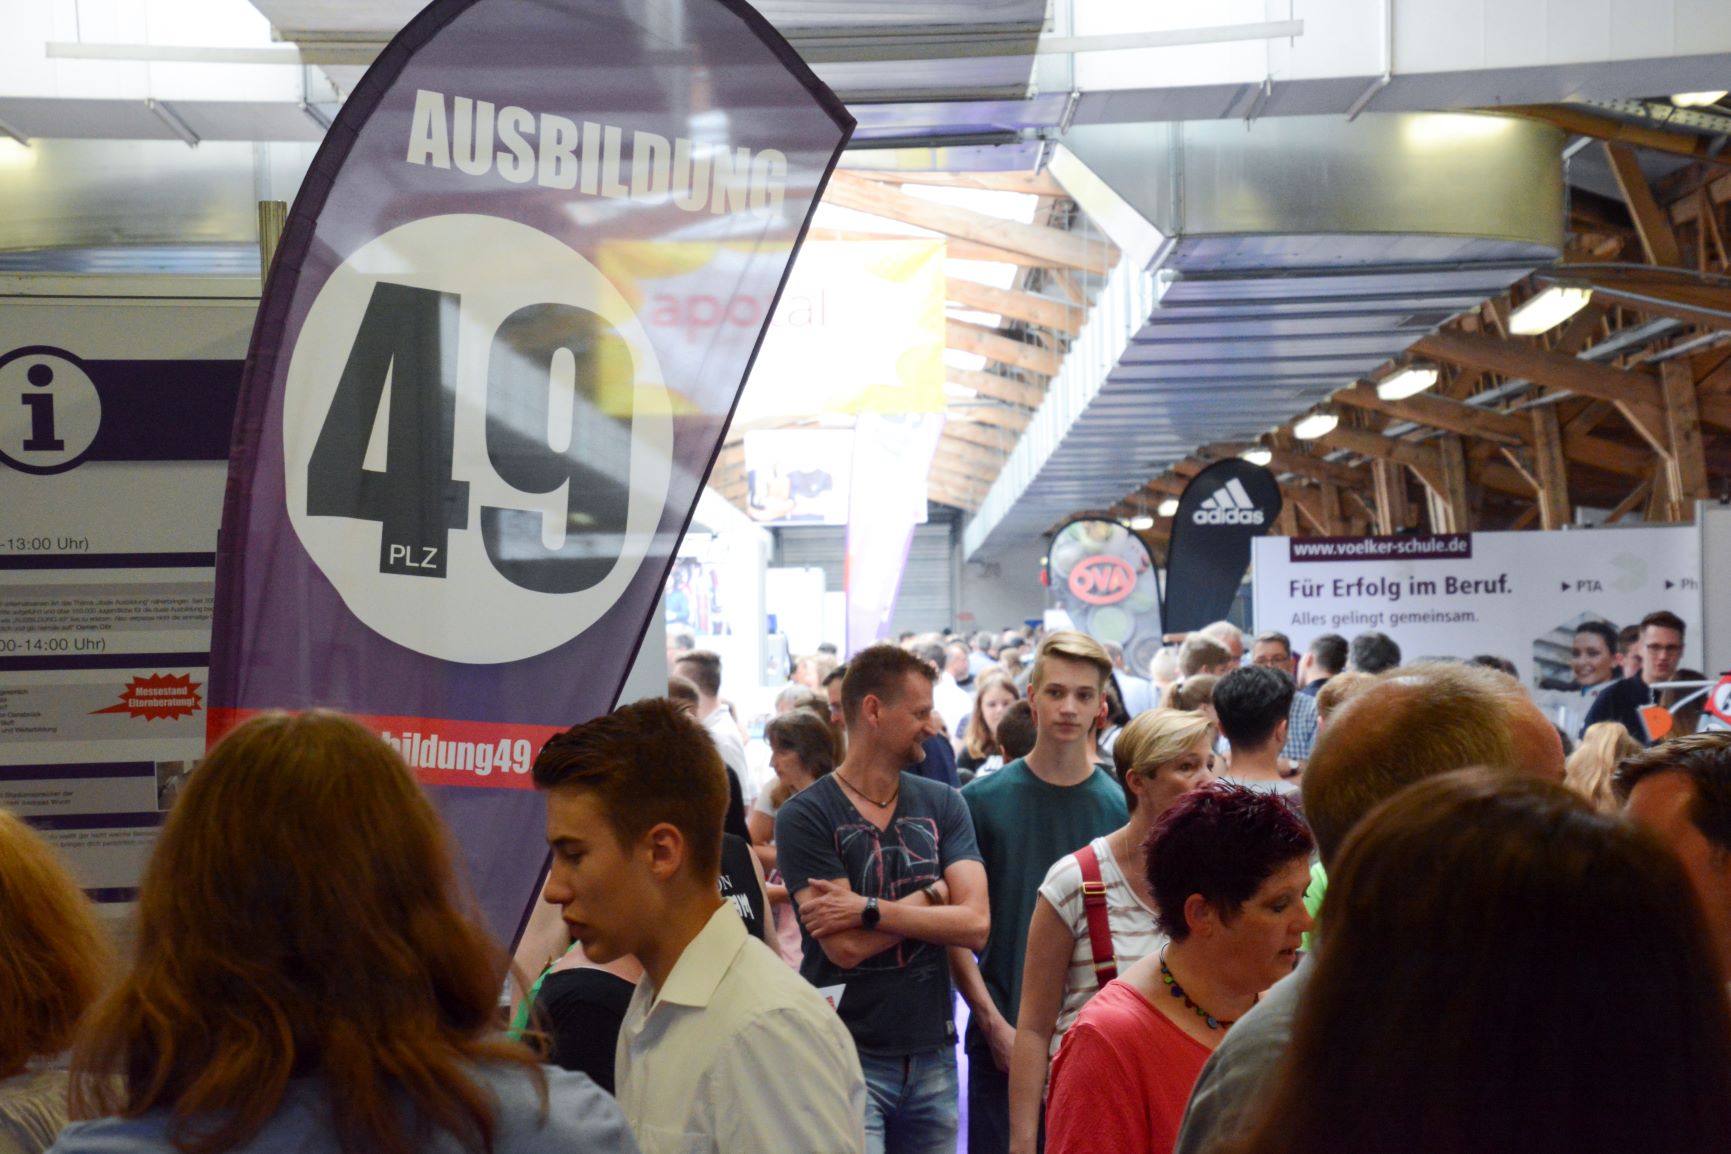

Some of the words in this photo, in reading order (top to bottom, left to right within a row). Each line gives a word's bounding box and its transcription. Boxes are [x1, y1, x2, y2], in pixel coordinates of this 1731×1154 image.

[406, 89, 788, 217] AUSBILDUNG
[306, 281, 635, 595] 49
[1192, 508, 1265, 525] adidas
[57, 537, 89, 552] Uhr)
[1294, 537, 1467, 556] www.voelker-schule.de
[389, 544, 437, 569] PLZ
[1290, 578, 1324, 598] Für
[1333, 577, 1401, 601] Erfolg
[1409, 576, 1436, 595] im
[1445, 573, 1512, 595] Beruf.
[1577, 580, 1603, 592] PTA
[1291, 611, 1327, 626] Alles
[1331, 611, 1385, 628] gelingt
[1389, 608, 1480, 626] gemeinsam.
[75, 637, 106, 652] Uhr)
